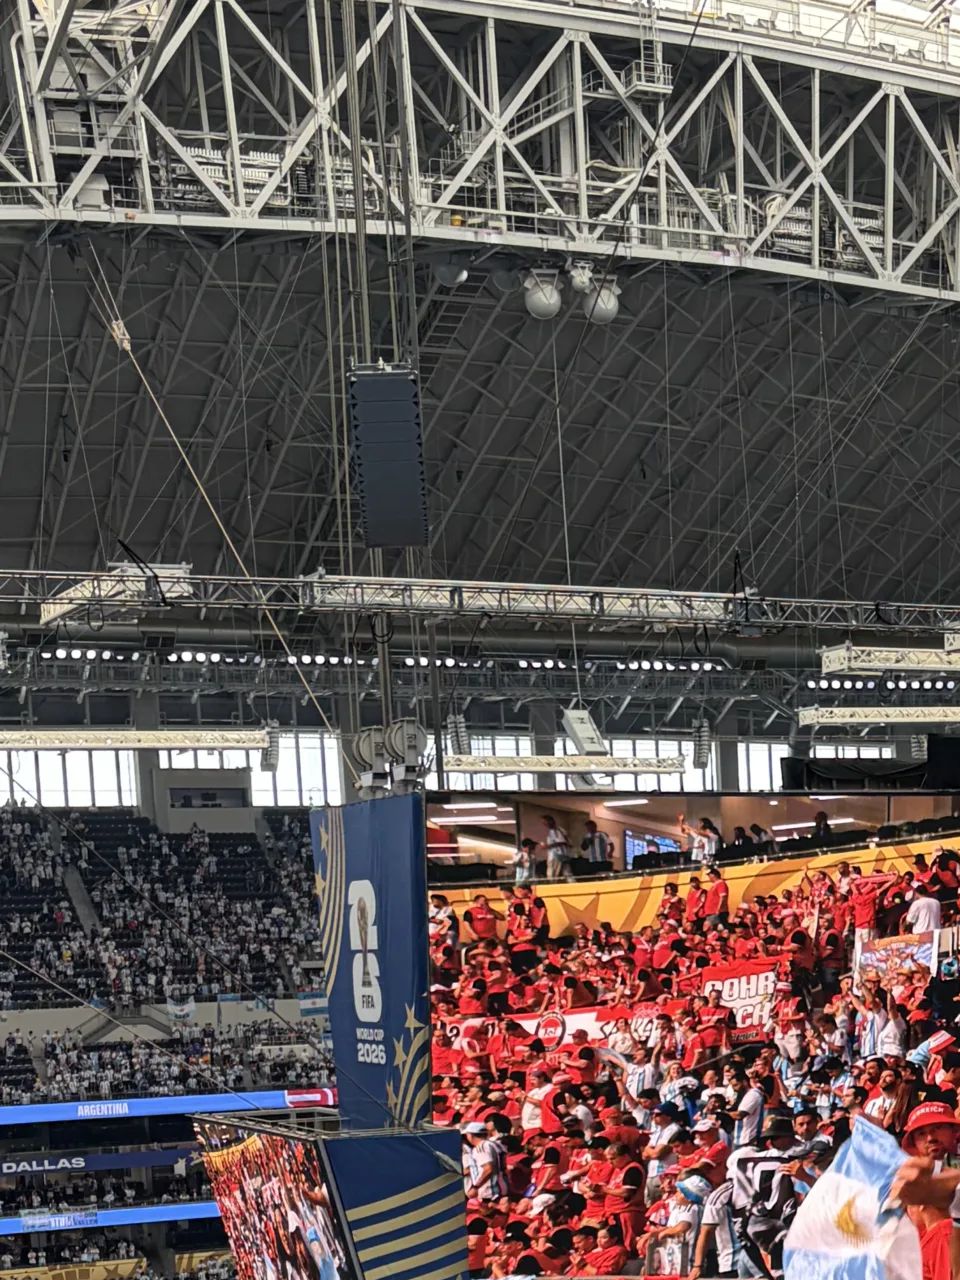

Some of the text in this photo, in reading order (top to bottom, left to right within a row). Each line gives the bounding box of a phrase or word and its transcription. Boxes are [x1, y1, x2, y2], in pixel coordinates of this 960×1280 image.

[361, 994, 376, 1009] FIFA
[356, 1028, 385, 1041] WORLD CUP
[357, 1043, 387, 1065] 2026
[77, 1102, 129, 1117] ARGENTINA
[2, 1157, 86, 1174] DALLAS
